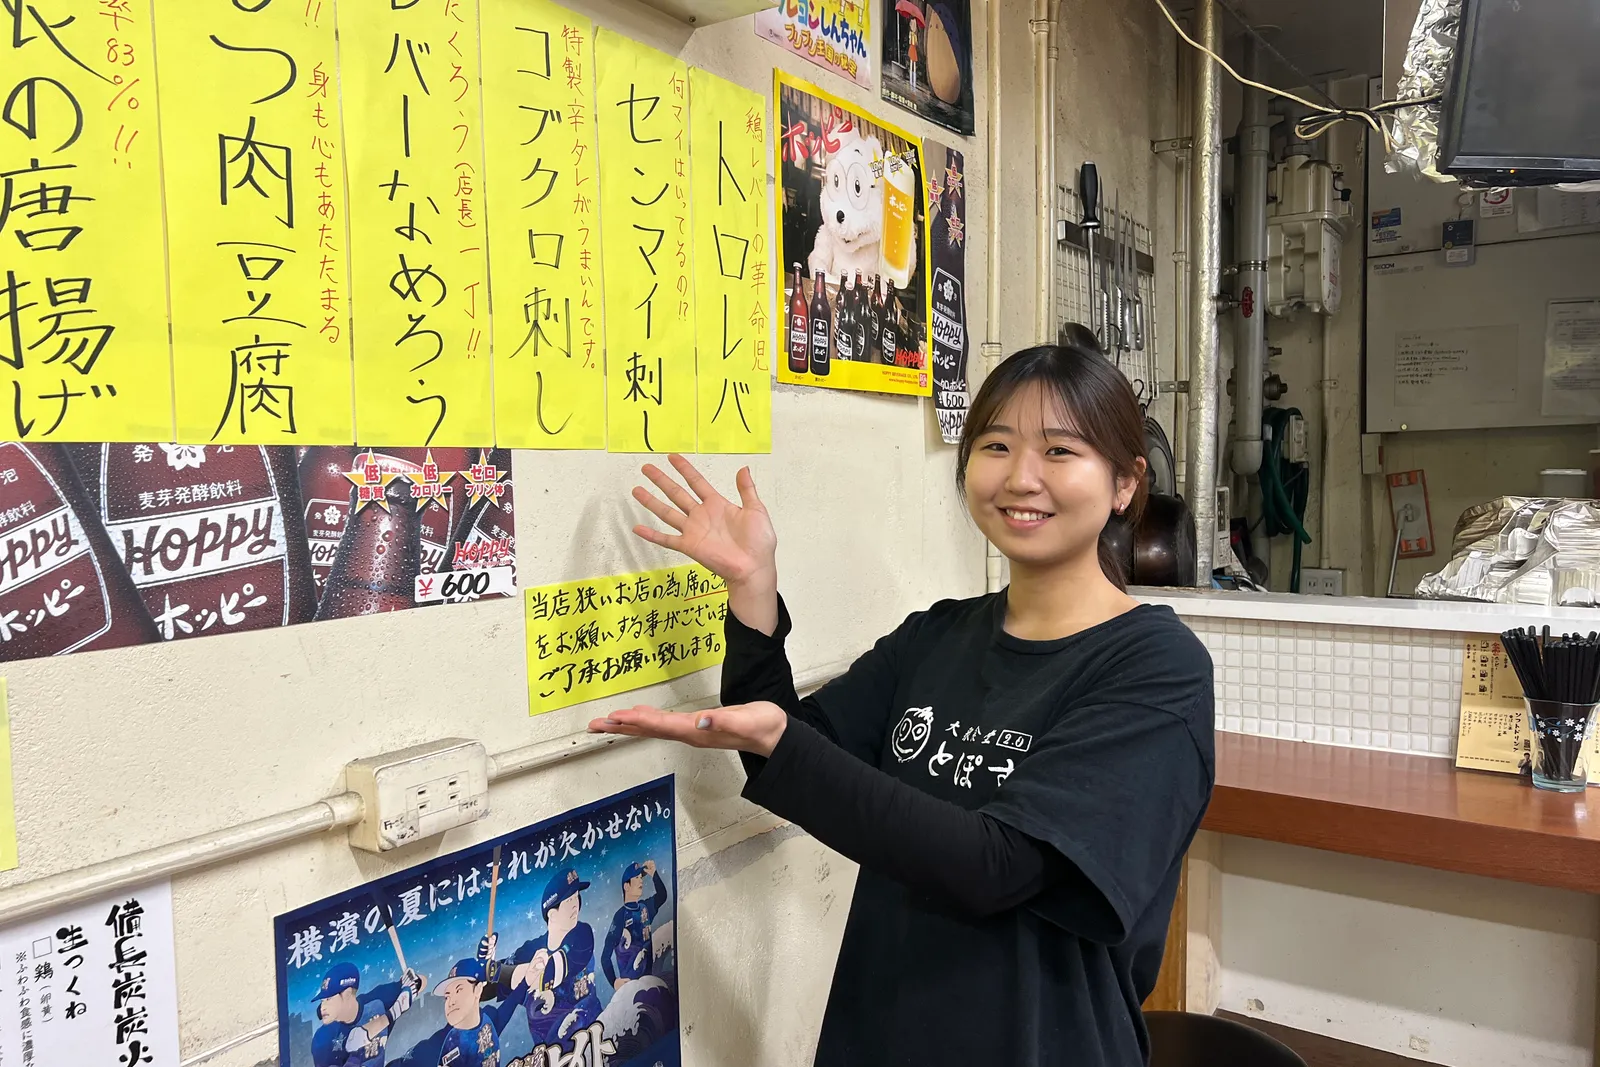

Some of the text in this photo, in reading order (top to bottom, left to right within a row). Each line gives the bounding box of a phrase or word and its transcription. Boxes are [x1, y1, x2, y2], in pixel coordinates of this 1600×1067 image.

[781, 105, 853, 163] ホッピー
[306, 62, 341, 344] 身も心もあたたまる
[509, 26, 573, 435] コブクロ刺し
[616, 83, 670, 451] センマイ刺し
[745, 106, 769, 372] 鶏レバーの革命児
[710, 120, 752, 434] トロレバ
[138, 478, 243, 510] 麦芽発酵飲料
[411, 484, 453, 498] カロリー
[465, 483, 505, 497] プリン体
[470, 465, 496, 480] ゼロ
[452, 537, 511, 563] Hoppy
[154, 583, 268, 640] ホッピー
[538, 632, 721, 698] ご了承お願い致します。
[56, 924, 89, 1020] 生つくね
